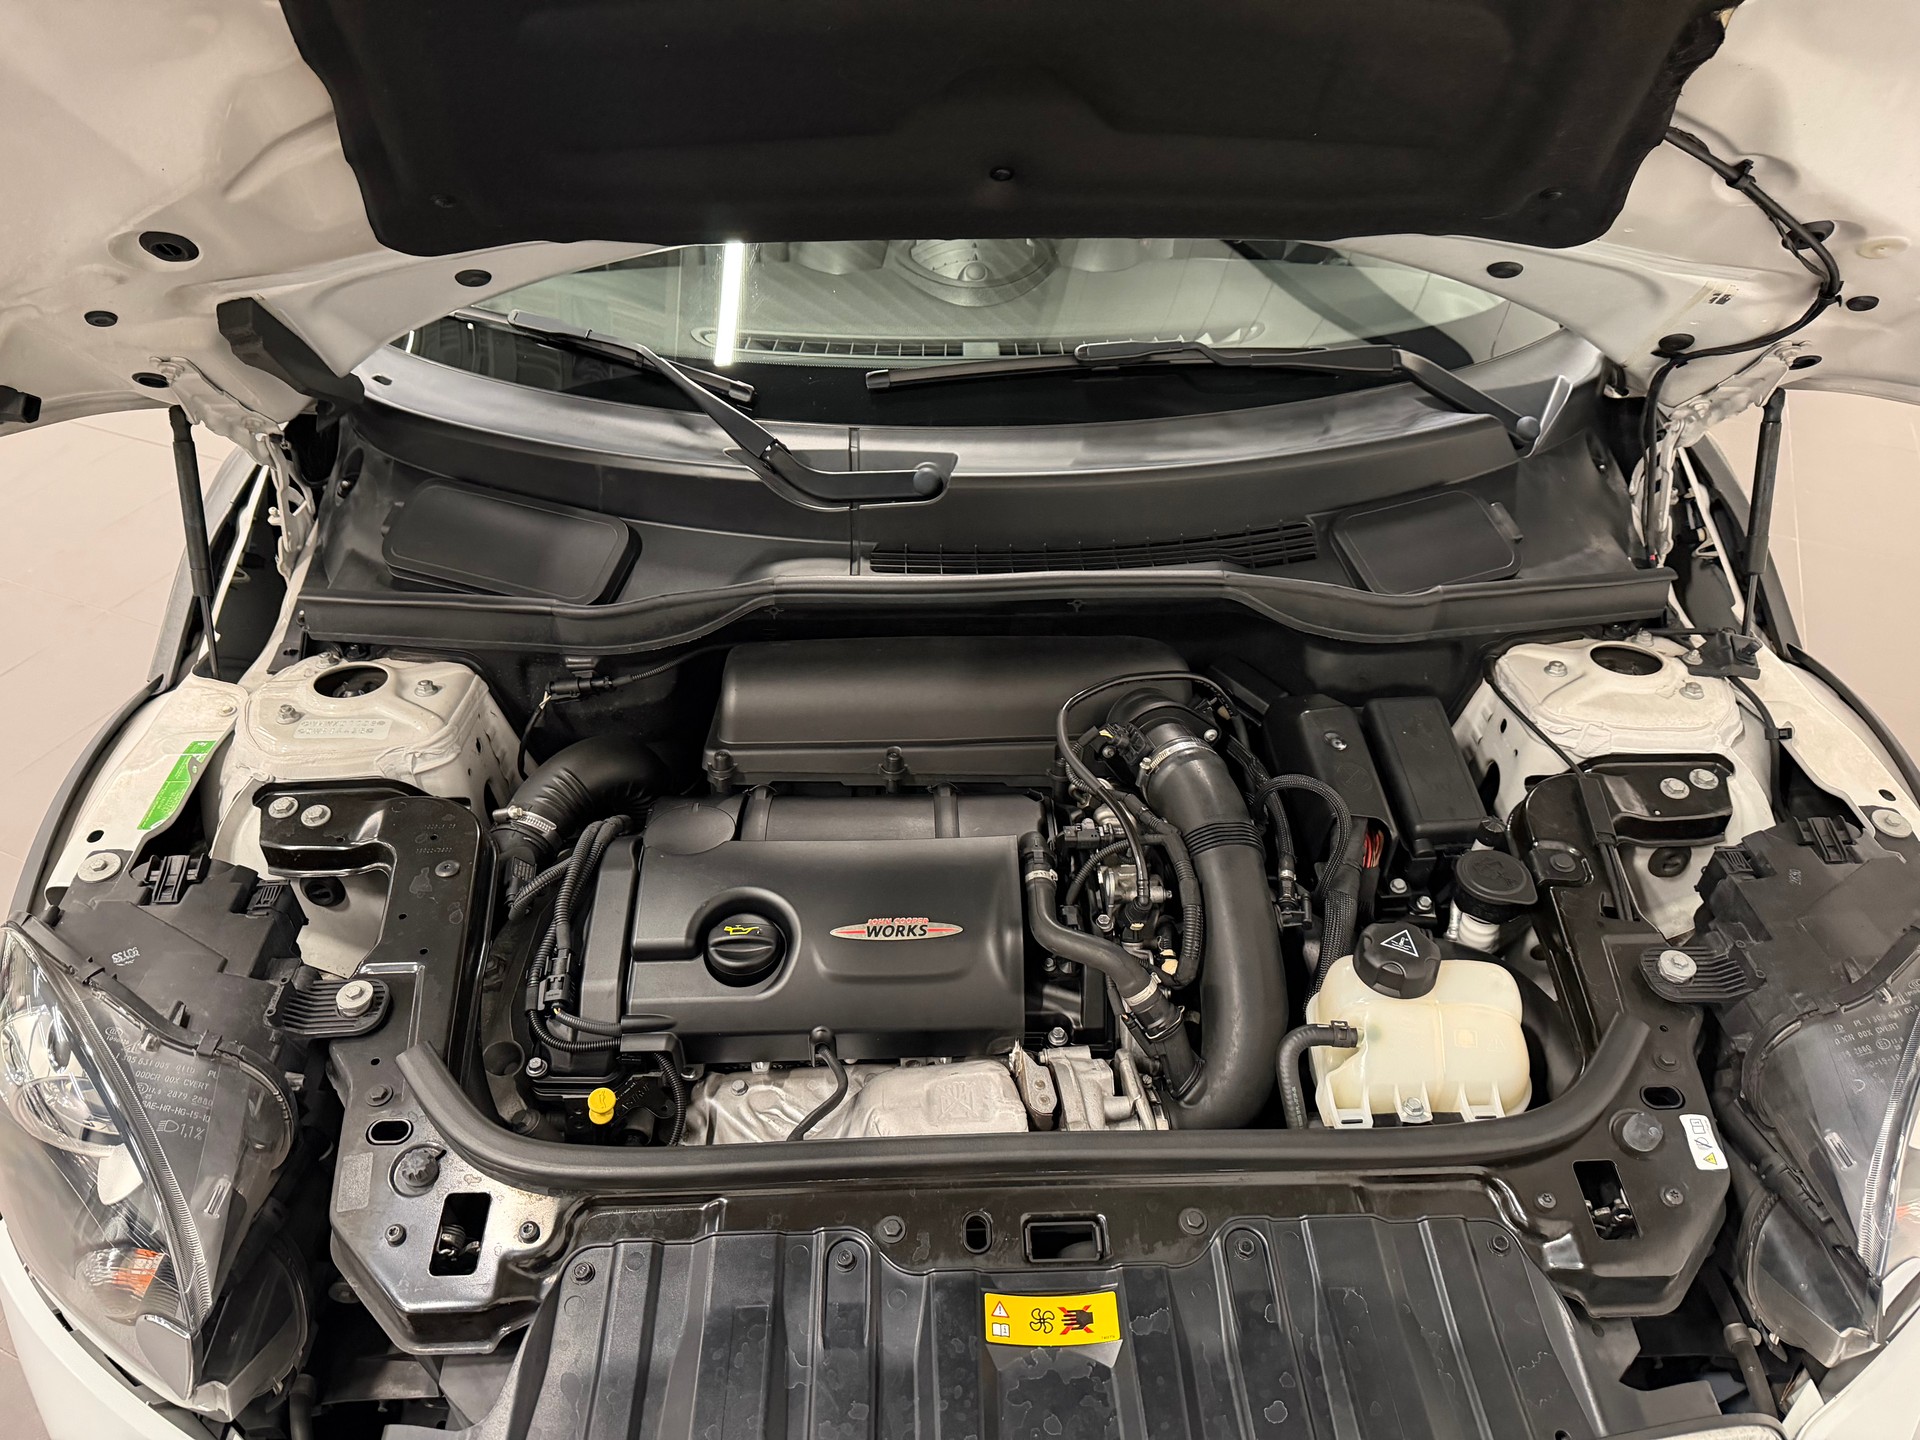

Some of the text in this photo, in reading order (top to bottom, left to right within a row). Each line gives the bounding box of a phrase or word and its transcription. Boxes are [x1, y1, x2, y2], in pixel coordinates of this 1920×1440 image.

[867, 917, 929, 925] JOHN COOPER
[866, 924, 928, 937] WORKS
[183, 1078, 210, 1091] CVERT
[167, 1090, 188, 1100] 2879
[180, 1122, 206, 1140] 1,1%
